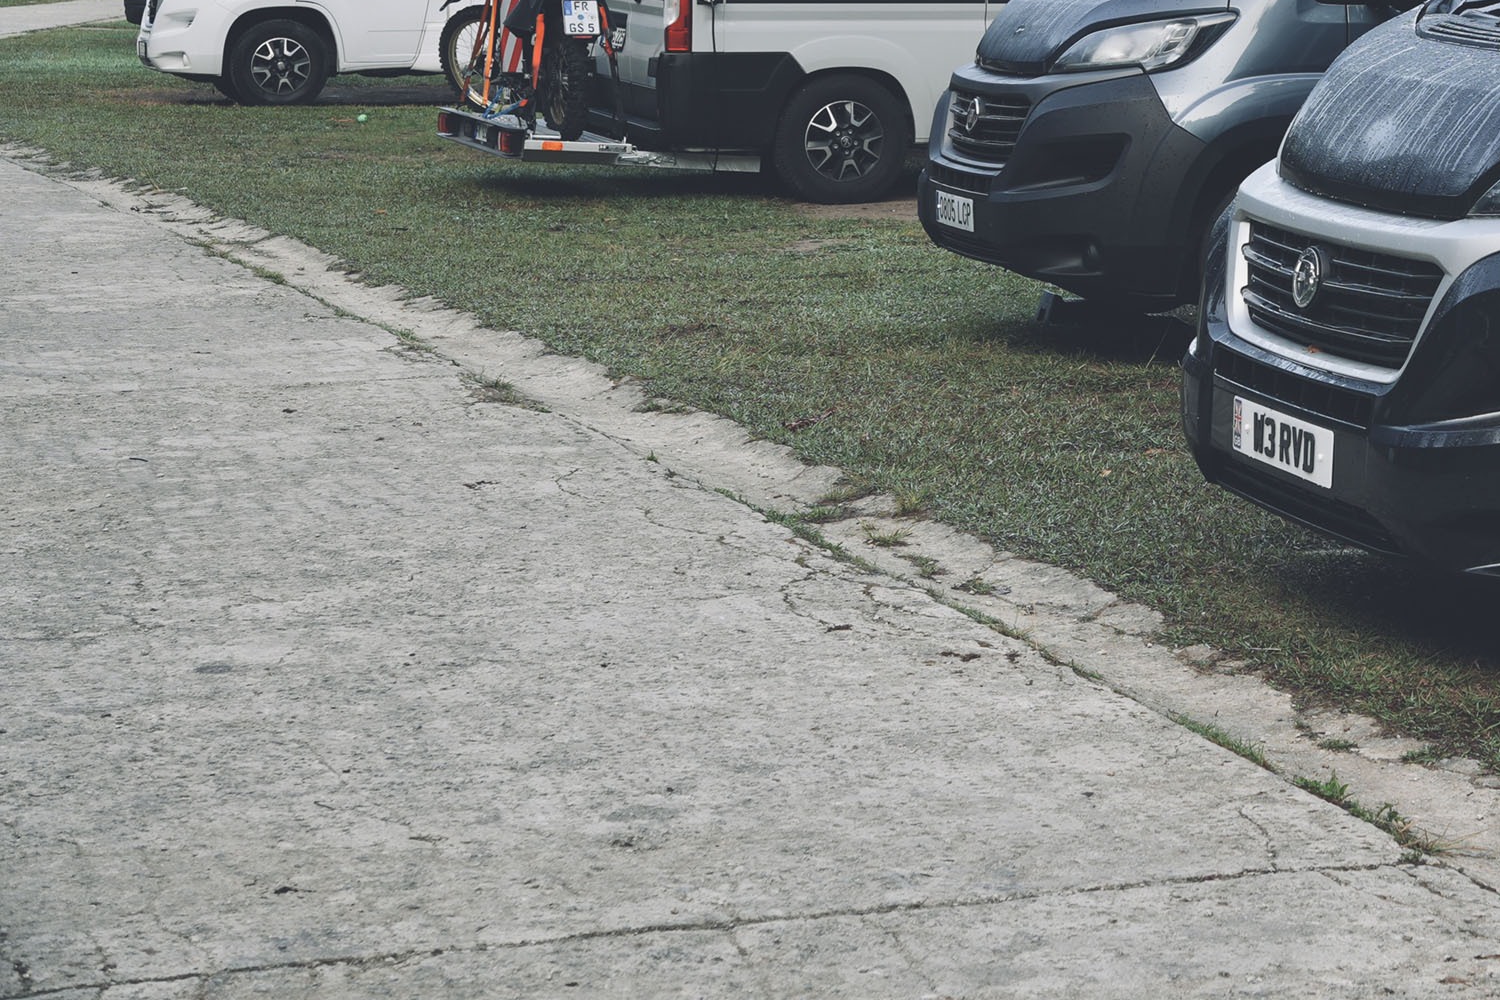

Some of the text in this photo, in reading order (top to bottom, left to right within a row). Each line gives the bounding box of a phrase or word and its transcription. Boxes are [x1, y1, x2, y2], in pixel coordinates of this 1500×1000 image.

[573, 1, 589, 11] FR
[569, 23, 595, 33] GS 5
[1279, 422, 1316, 474] RVD
